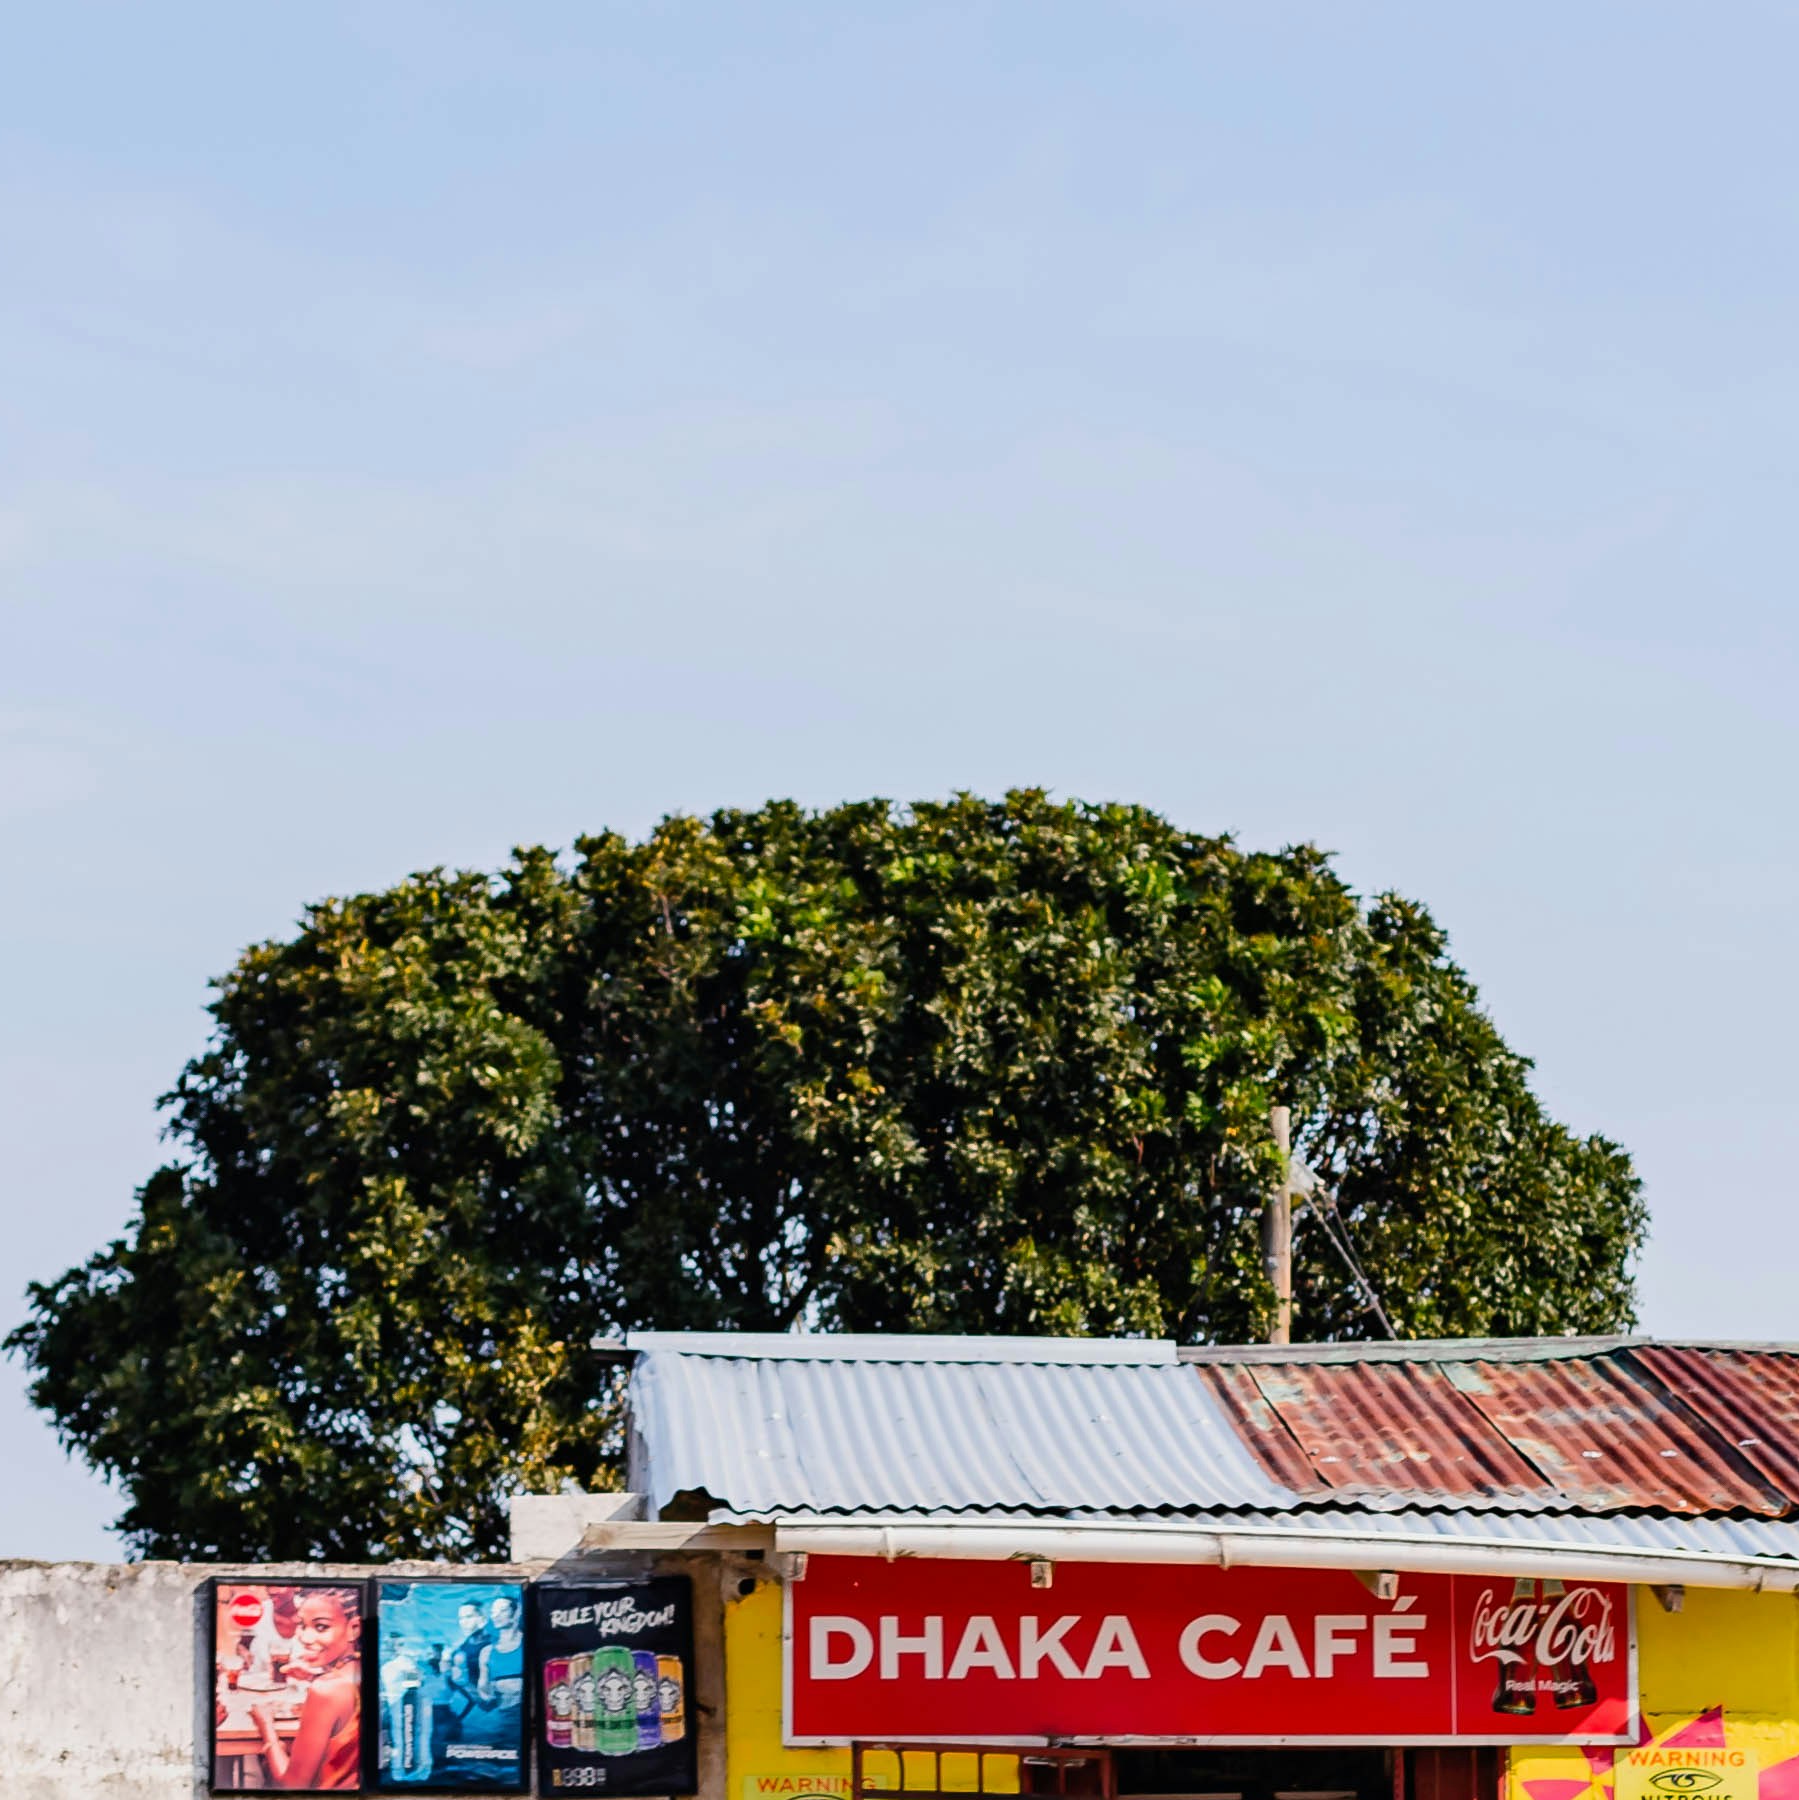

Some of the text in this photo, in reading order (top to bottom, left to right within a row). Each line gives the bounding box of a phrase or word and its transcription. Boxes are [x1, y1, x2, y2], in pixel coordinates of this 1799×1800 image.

[551, 1597, 636, 1628] RULE YOUR
[1470, 1587, 1615, 1665] Coca-Cola
[810, 1596, 1430, 1681] DHAKA CAFÉ
[1506, 1680, 1580, 1692] Real Magic
[1628, 1751, 1745, 1766] WARNING
